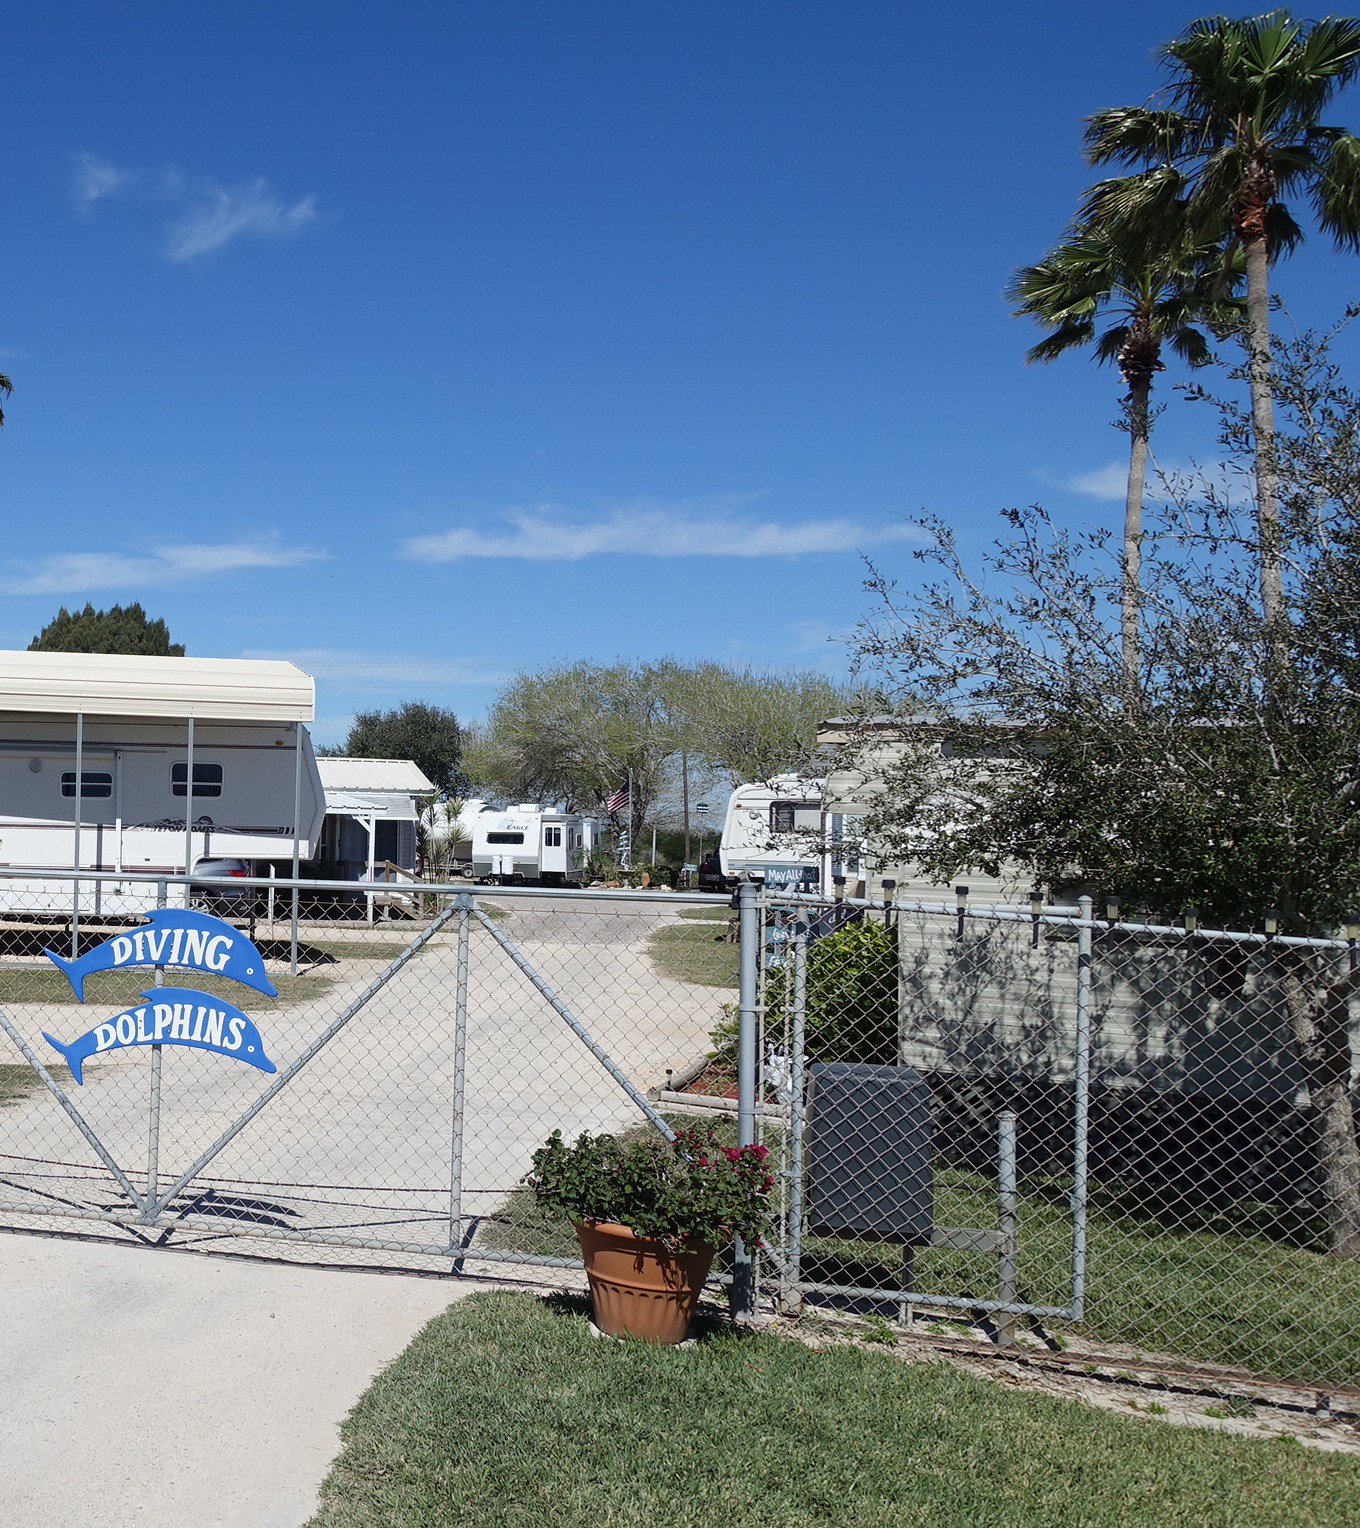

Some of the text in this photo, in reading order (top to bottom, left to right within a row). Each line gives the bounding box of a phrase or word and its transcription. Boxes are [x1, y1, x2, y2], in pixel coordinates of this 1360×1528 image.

[506, 823, 530, 831] EAGLE
[110, 928, 234, 971] DIVING
[93, 1003, 246, 1051] DOLPHINS
